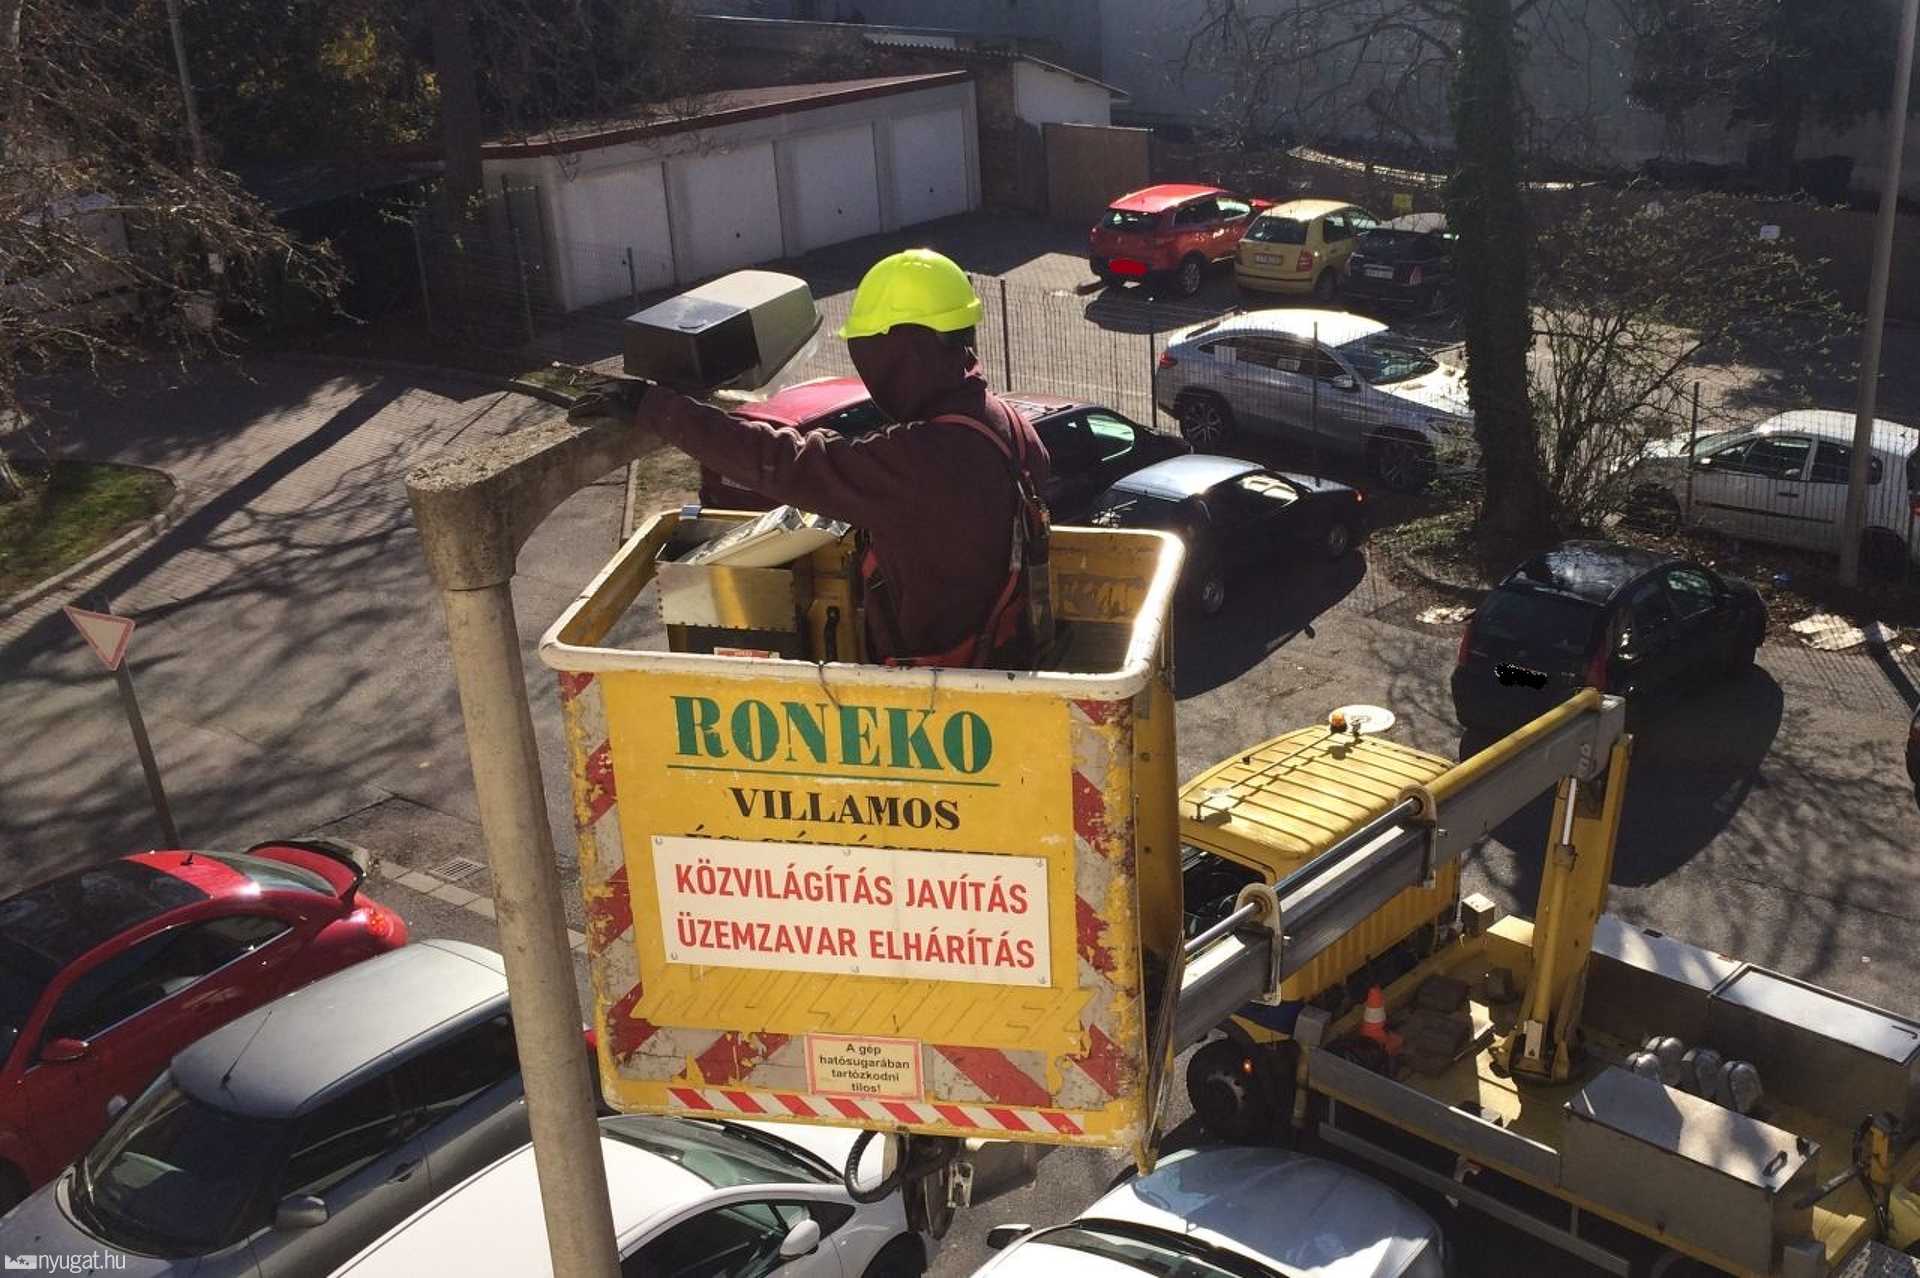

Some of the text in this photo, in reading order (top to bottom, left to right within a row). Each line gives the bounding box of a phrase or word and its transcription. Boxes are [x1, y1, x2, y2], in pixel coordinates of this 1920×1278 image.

[670, 695, 993, 774] RONEKO
[728, 786, 960, 831] VILLAMOS
[674, 858, 1029, 915] KÖZVILÁGÍTÁS JAVÍTÁS
[677, 911, 1035, 969] ÜZEMZAVAR ELHÁRÍTÁS
[845, 1042, 856, 1053] A
[851, 1082, 881, 1093] tilos!
